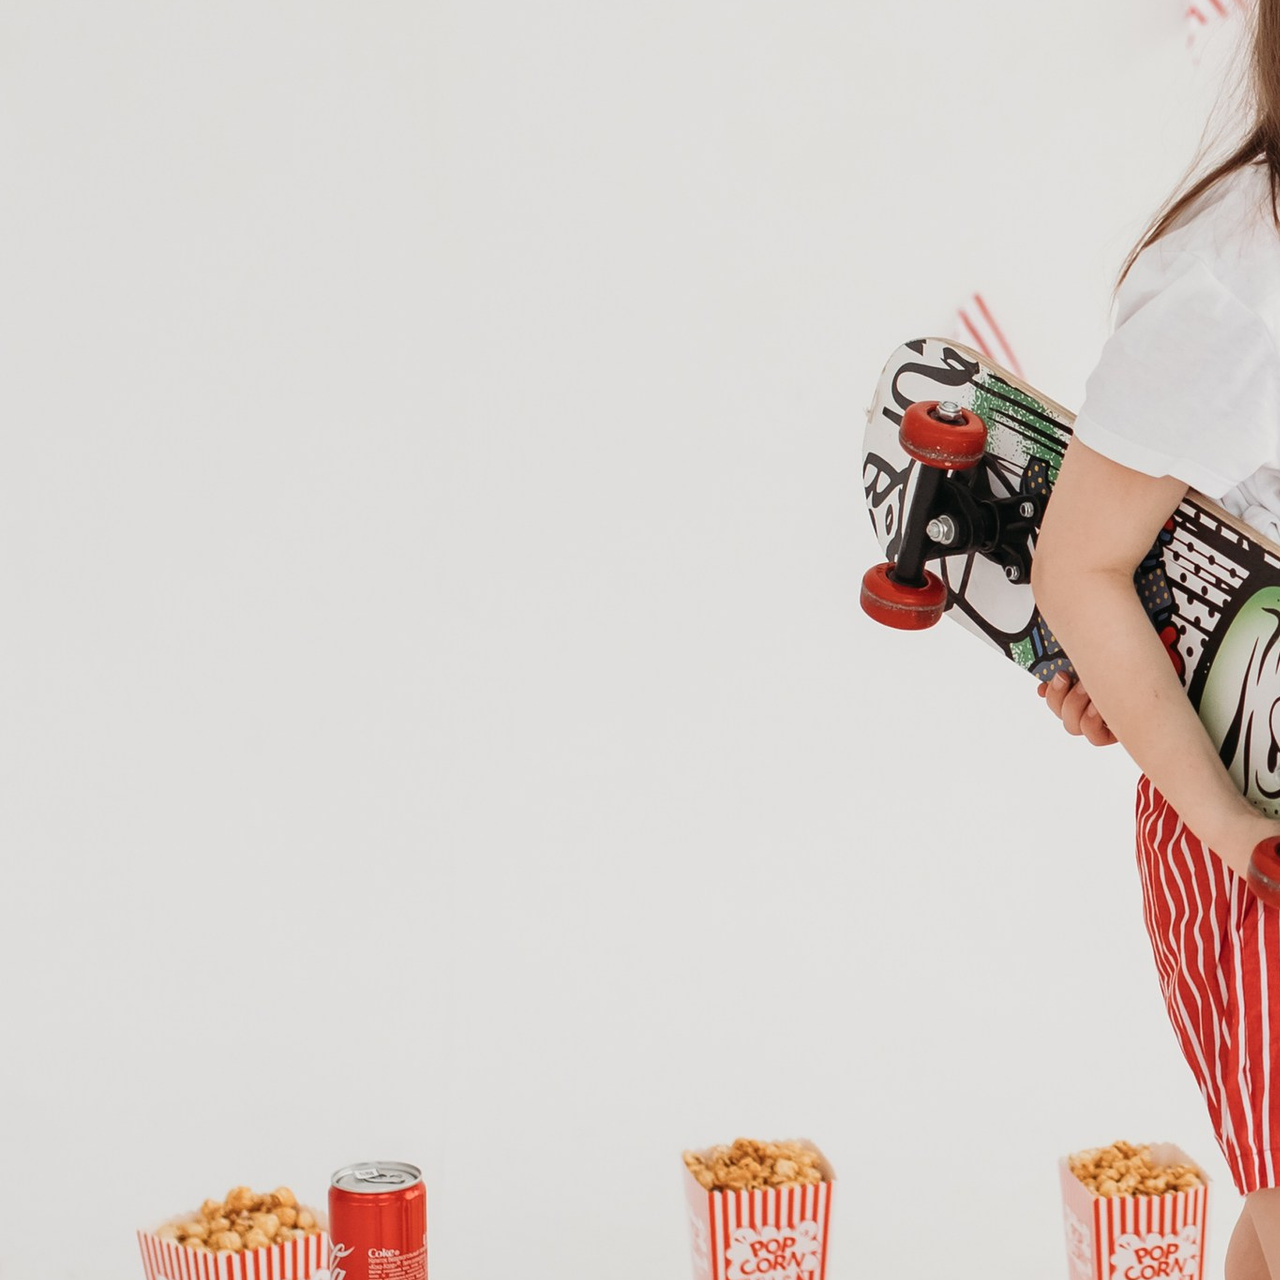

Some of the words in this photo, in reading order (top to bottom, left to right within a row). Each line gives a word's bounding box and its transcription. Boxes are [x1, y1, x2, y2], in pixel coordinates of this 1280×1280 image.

[750, 1237, 796, 1258] POP
[1134, 1243, 1179, 1265] POP
[740, 1252, 806, 1275] CORN
